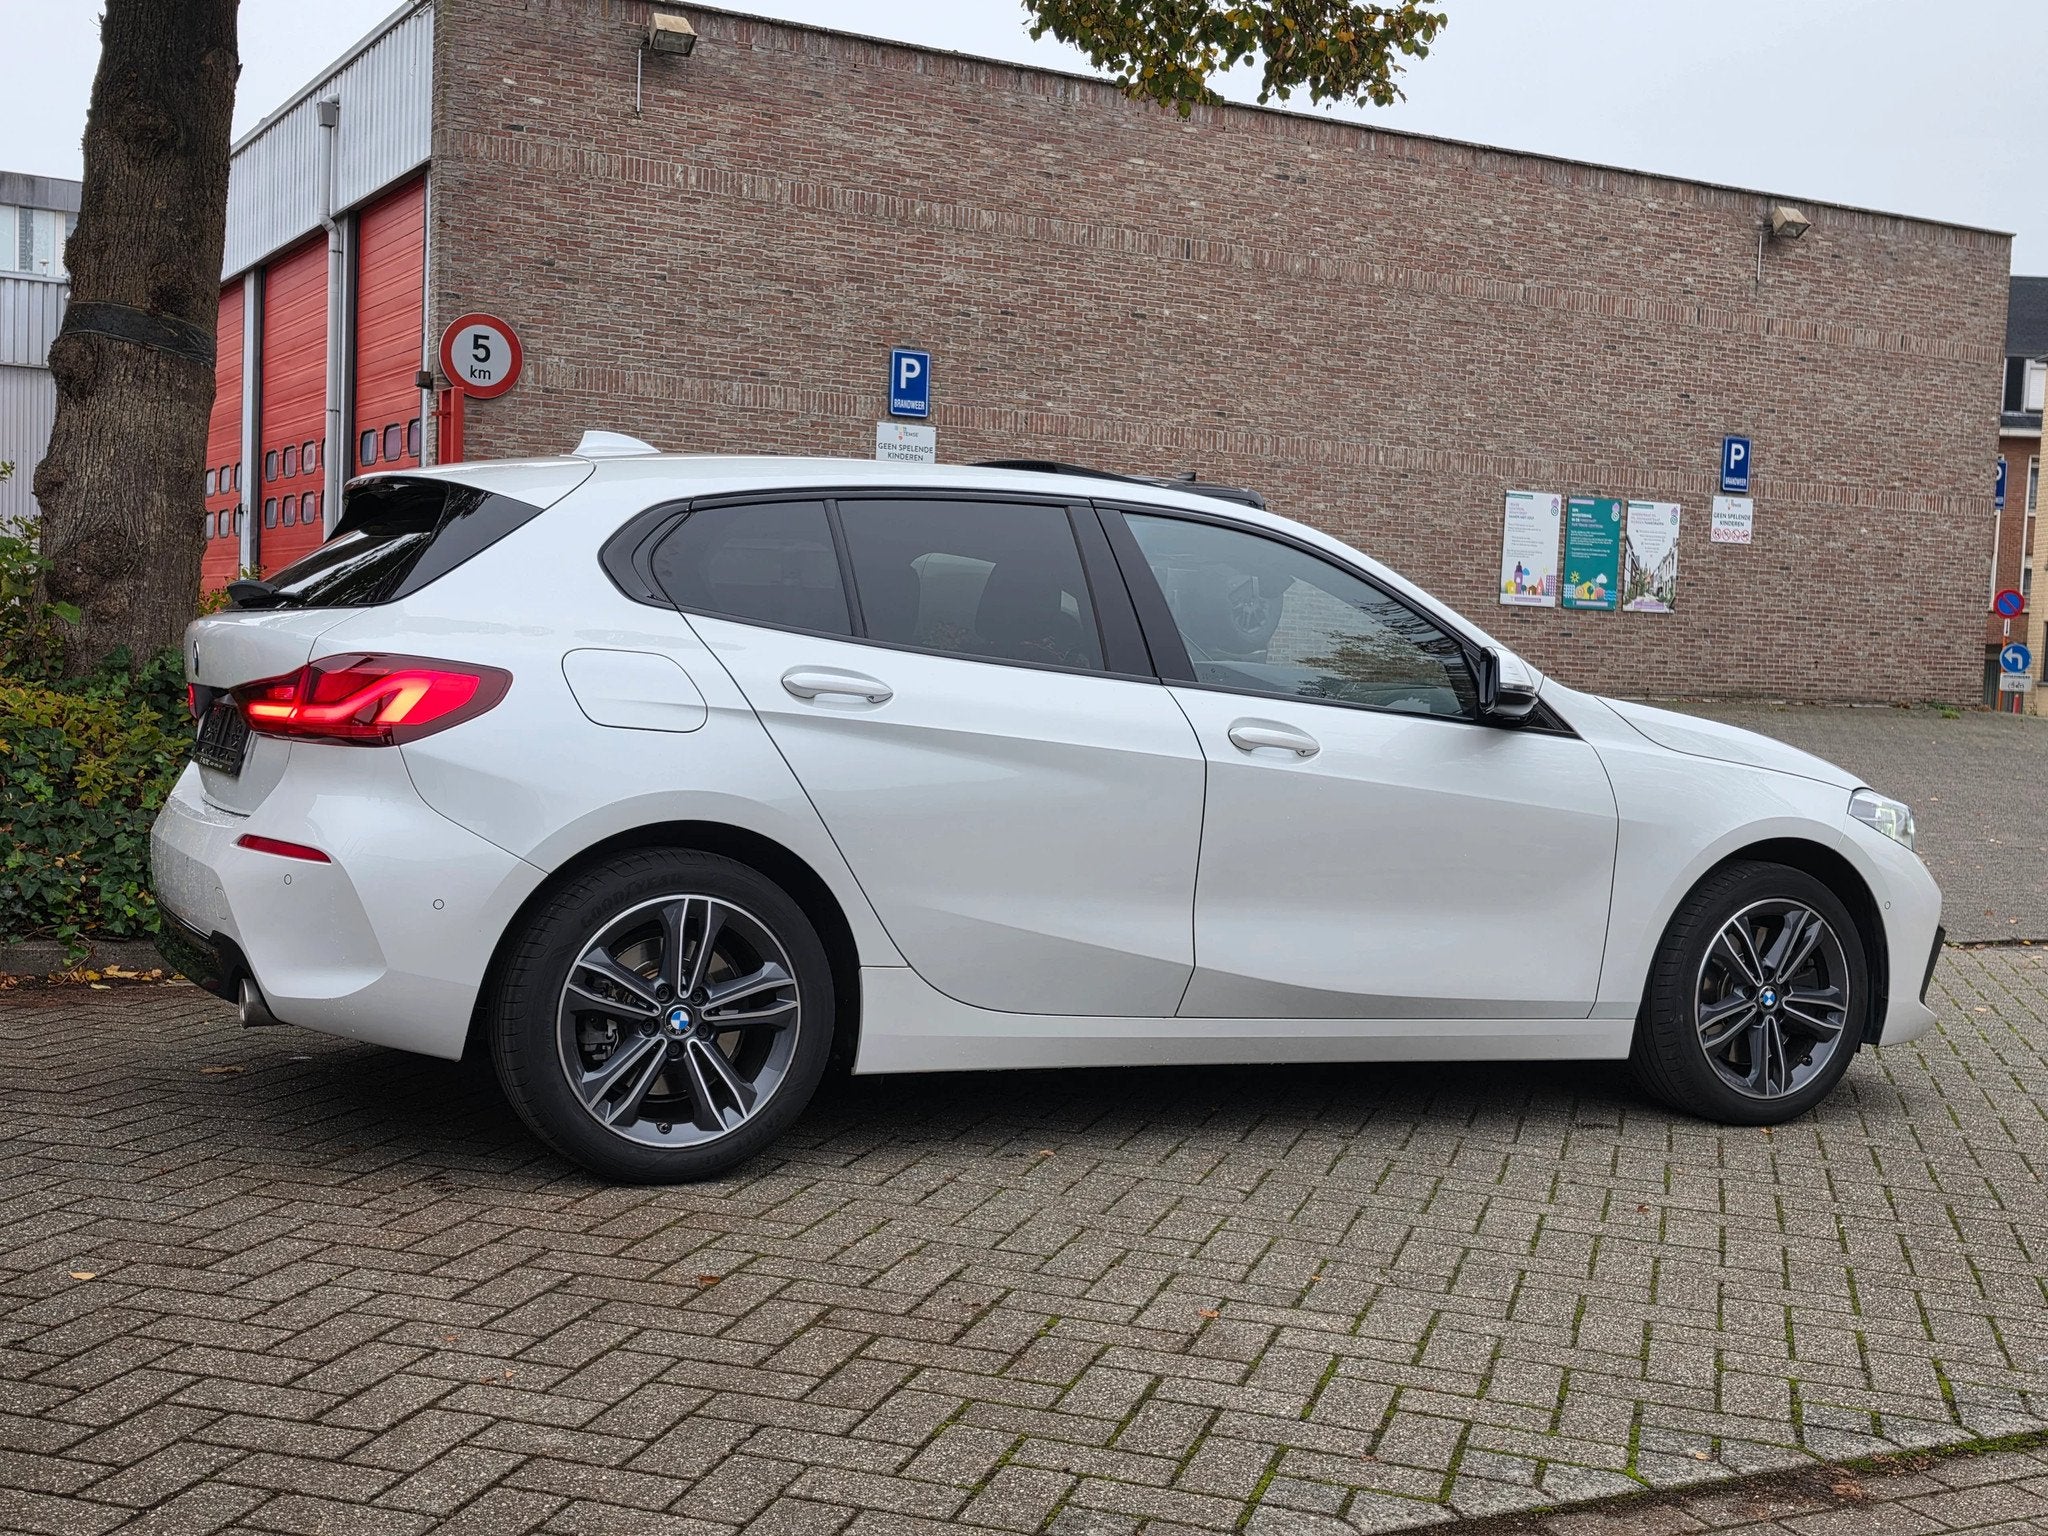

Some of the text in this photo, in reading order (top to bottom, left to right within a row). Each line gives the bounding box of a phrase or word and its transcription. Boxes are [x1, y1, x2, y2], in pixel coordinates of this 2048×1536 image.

[472, 333, 491, 363] 5
[470, 365, 491, 380] km
[900, 357, 921, 389] P
[893, 399, 925, 411] BRANDWEER
[878, 442, 934, 454] GEEN SPELENDE
[887, 451, 924, 461] KINDEREN
[1730, 443, 1745, 470] P
[1713, 511, 1751, 521] GEEN SPELENDE
